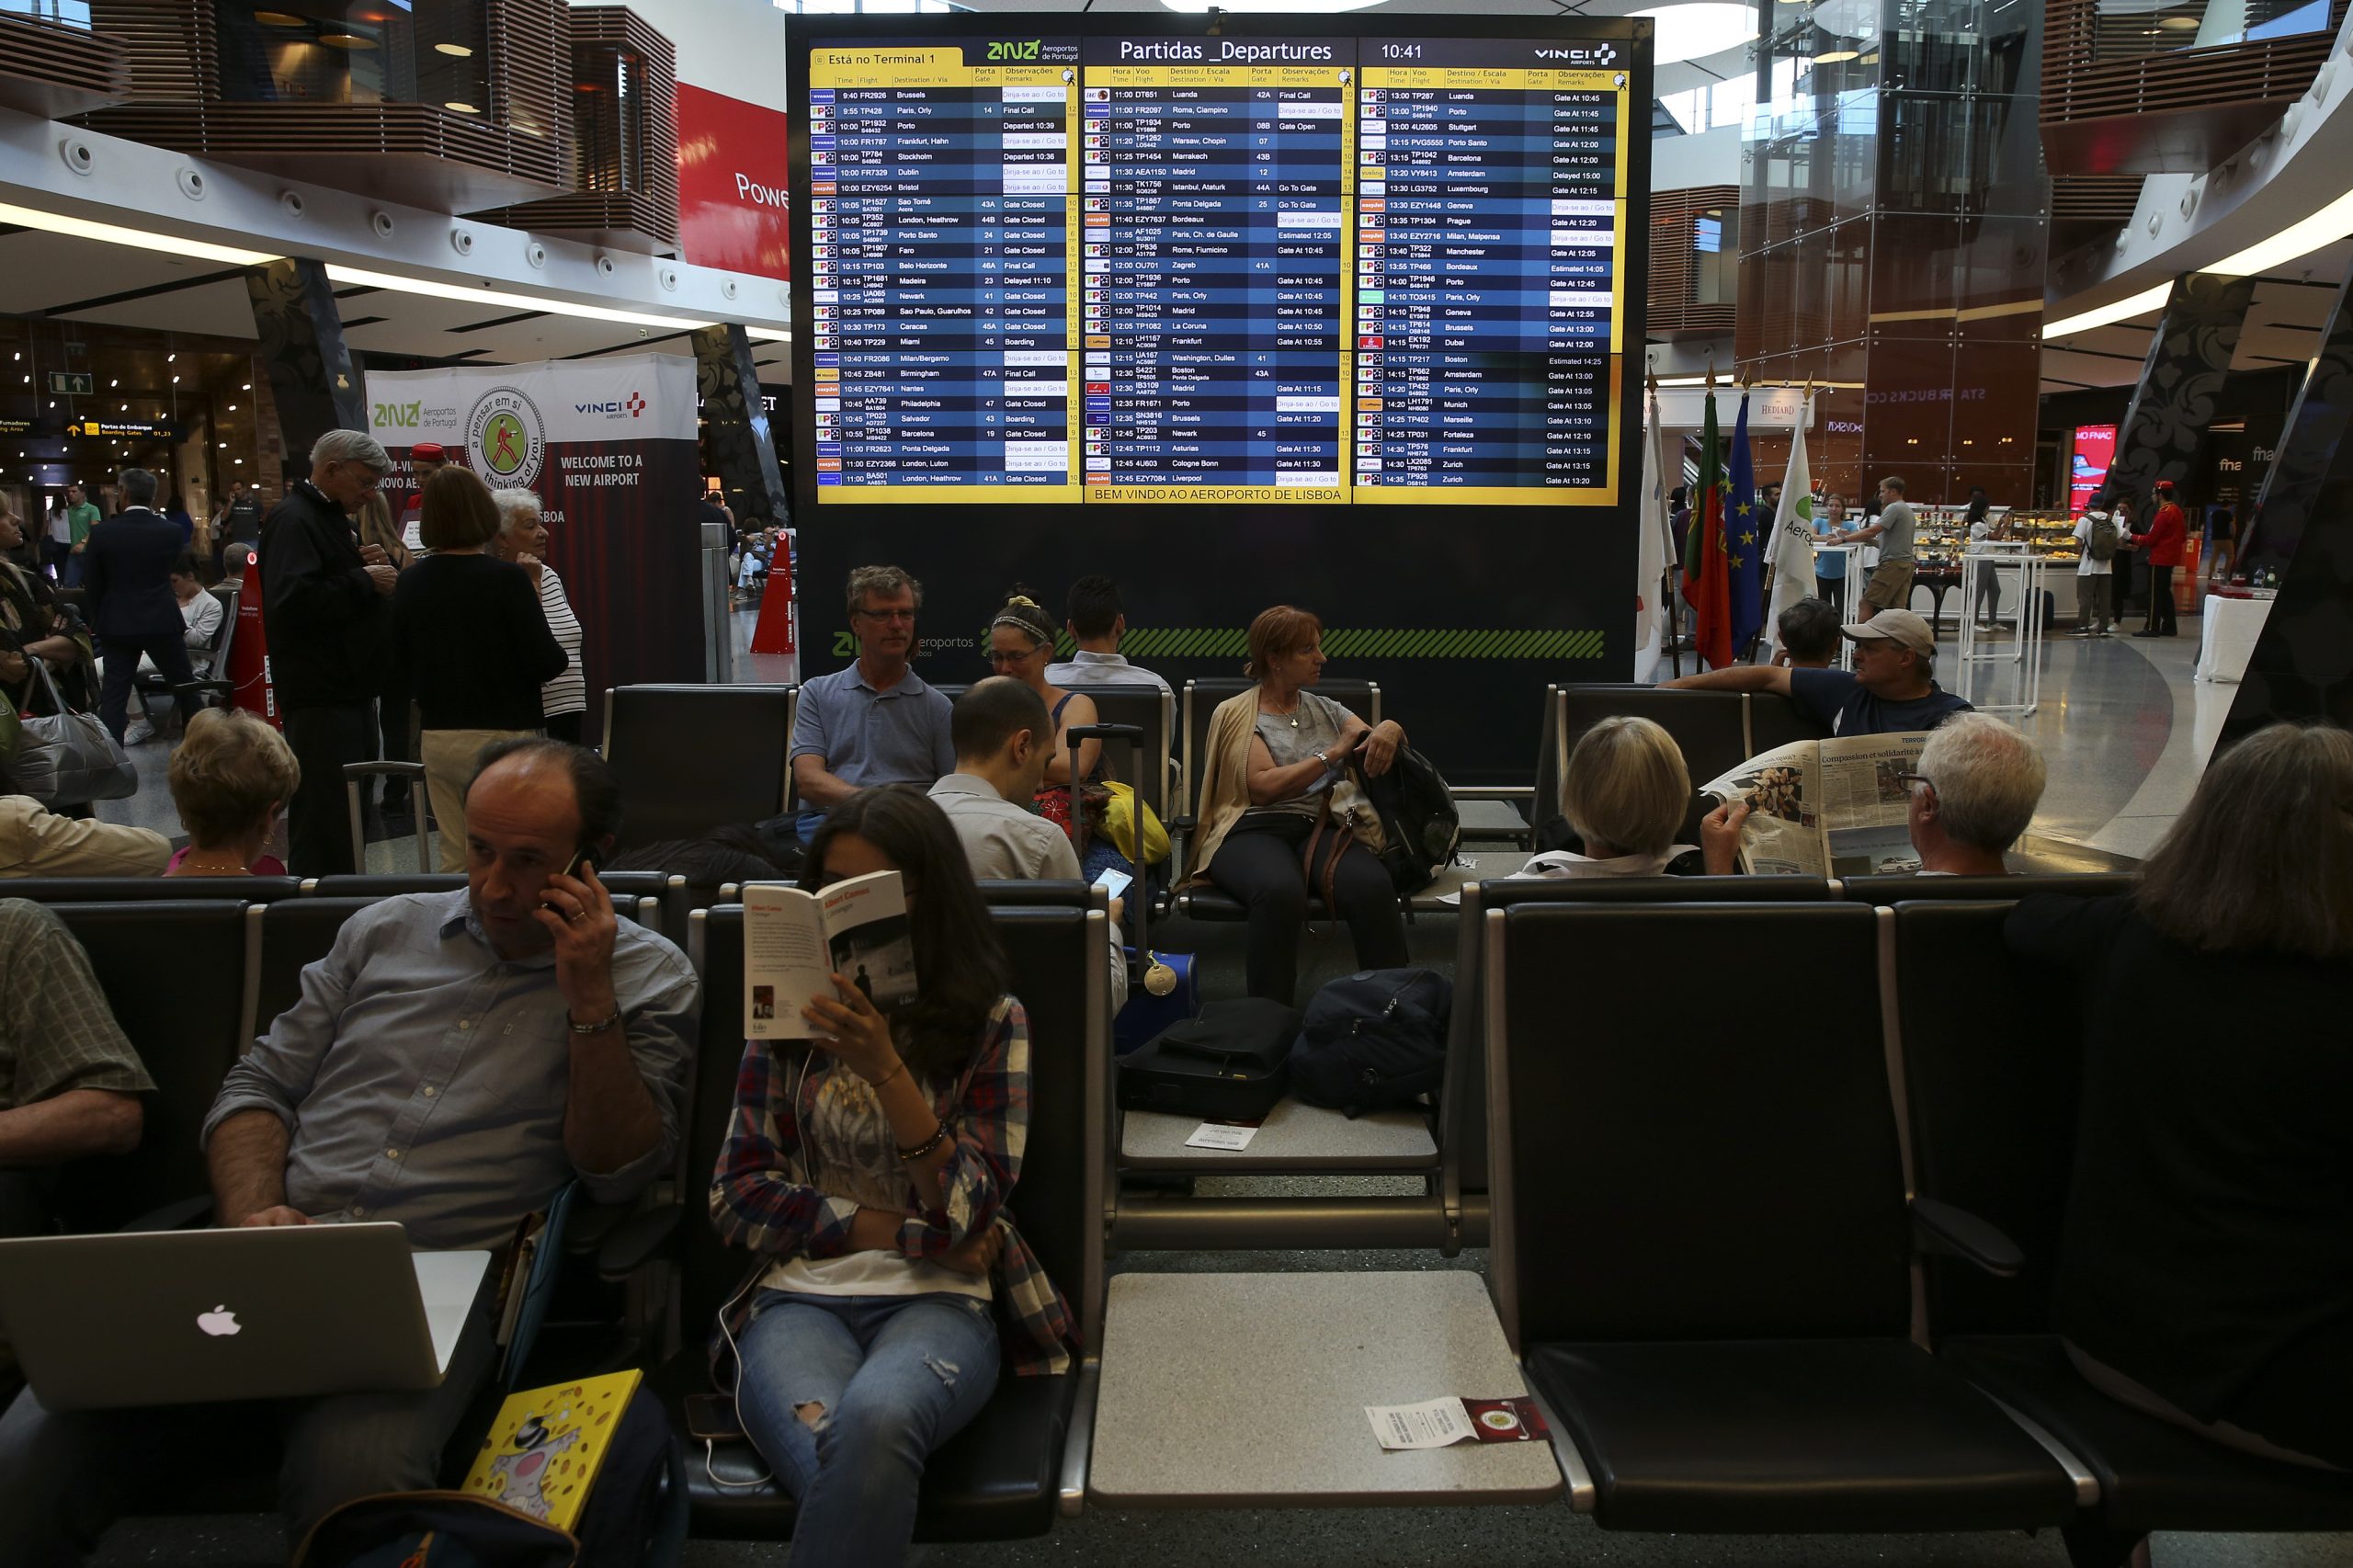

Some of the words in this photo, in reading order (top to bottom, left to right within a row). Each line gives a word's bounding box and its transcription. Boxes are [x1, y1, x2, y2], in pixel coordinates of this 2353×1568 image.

[1042, 45, 1078, 53] Aeroportos
[1120, 41, 1202, 60] Partidas
[1381, 45, 1421, 59] 10:41
[1534, 49, 1589, 59] VINCI
[828, 54, 852, 64] Está
[856, 55, 870, 64] no
[874, 54, 926, 64] Terminal
[929, 54, 935, 63] 1
[1051, 52, 1078, 62] Portugal
[1282, 68, 1330, 76] Observações
[860, 107, 882, 115] TP428
[897, 107, 916, 115] Paris,
[916, 107, 932, 115] Orly
[839, 122, 858, 131] 10:00
[1003, 122, 1034, 131] Departed
[1468, 139, 1488, 147] Santo
[1115, 153, 1133, 161] 11:25
[1390, 169, 1409, 177] 13:20
[1553, 172, 1581, 180] Delayed
[1172, 183, 1200, 192] Istanbul,
[1201, 183, 1226, 191] Ataturk
[899, 216, 926, 225] London,
[926, 216, 959, 224] Heathrow
[1022, 216, 1045, 224] Closed
[1004, 277, 1030, 285] Delayed
[1032, 277, 1051, 285] 11:10
[1115, 323, 1133, 331] 12:05
[1278, 323, 1293, 331] Gate
[1294, 323, 1302, 331] At
[1303, 323, 1323, 331] 10:50
[843, 338, 862, 347] 10:40
[1005, 338, 1035, 347] Boarding
[423, 407, 457, 417] Aeroportos
[575, 403, 622, 413] VINCI
[1761, 404, 1795, 415] HEDIARD
[472, 401, 493, 437] pensar
[494, 397, 510, 406] em
[511, 401, 522, 411] si
[423, 418, 432, 427] de
[432, 417, 457, 428] Portugal
[2091, 431, 2112, 440] FNAC
[483, 472, 526, 490] thinking
[524, 461, 534, 477] of
[530, 437, 540, 463] you
[561, 457, 615, 469] WELCOME
[617, 456, 631, 468] TO
[634, 455, 642, 467] A
[902, 460, 928, 469] London,
[564, 474, 590, 486] NEW
[593, 473, 640, 486] AIRPORT
[1095, 490, 1122, 500] BEM
[1126, 490, 1166, 500] VINDO
[1169, 490, 1188, 500] AO
[1189, 490, 1271, 500] AEROPORTO
[1274, 490, 1292, 500] DE
[1295, 490, 1341, 500] LISBOA
[1822, 752, 1868, 764] Compassion
[1877, 748, 1914, 759] solidarité
